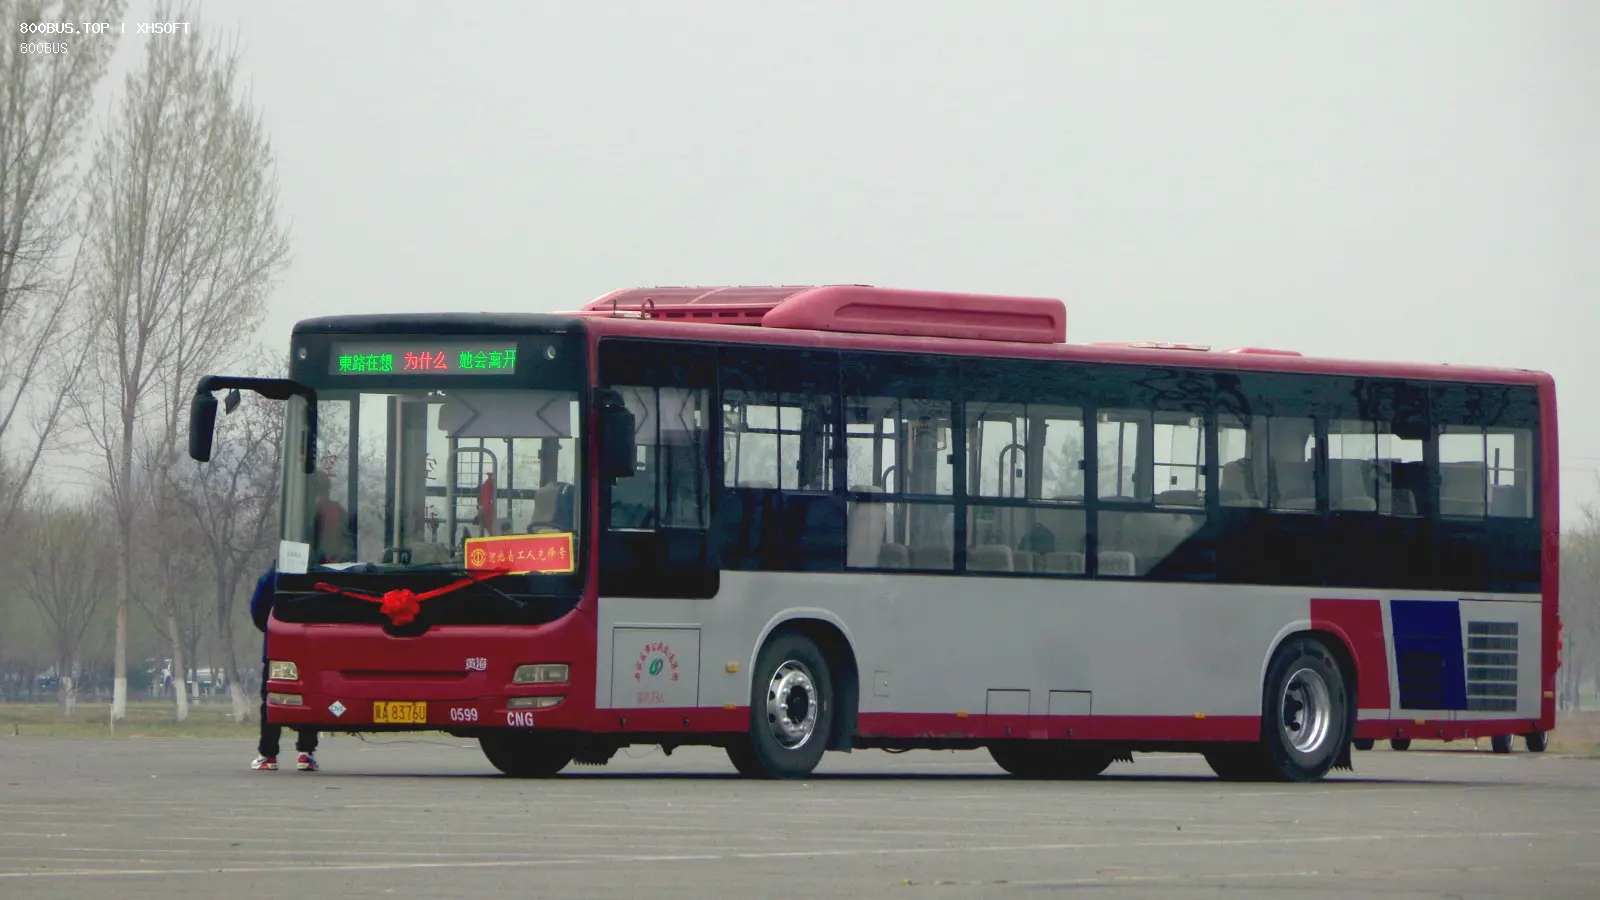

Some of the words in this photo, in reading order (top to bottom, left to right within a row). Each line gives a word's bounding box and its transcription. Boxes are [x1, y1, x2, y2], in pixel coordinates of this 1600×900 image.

[403, 351, 448, 370] 为什么
[458, 349, 517, 369] 她会离开
[450, 707, 479, 722] 0599
[507, 712, 534, 727] CNG
